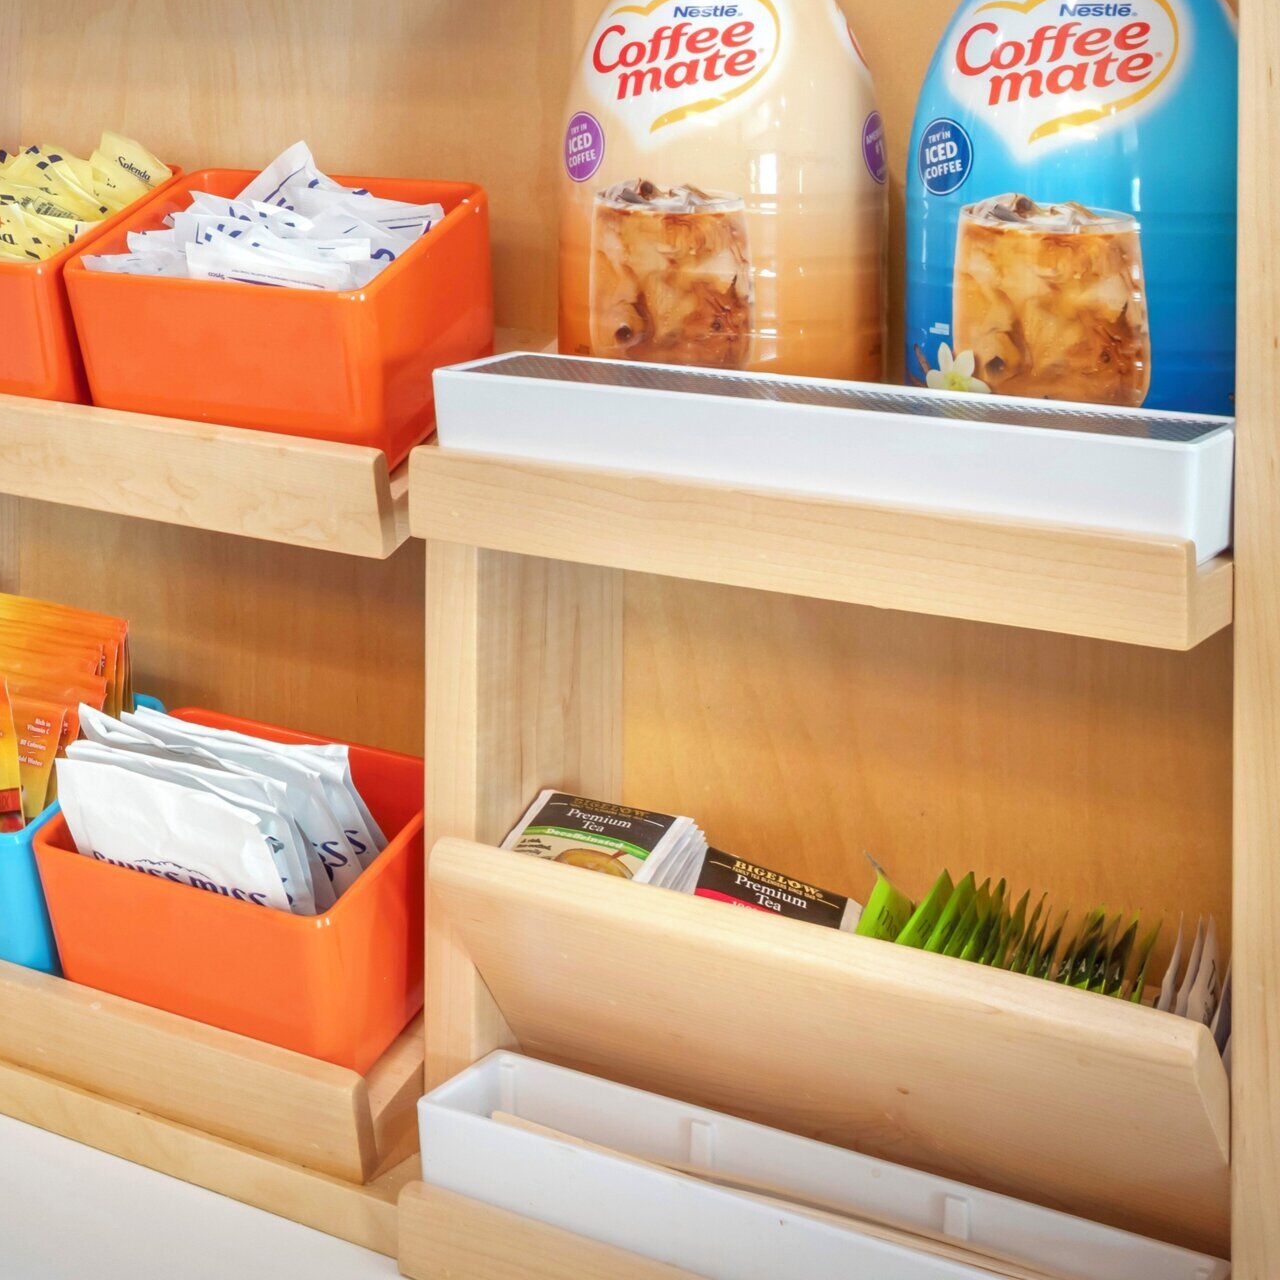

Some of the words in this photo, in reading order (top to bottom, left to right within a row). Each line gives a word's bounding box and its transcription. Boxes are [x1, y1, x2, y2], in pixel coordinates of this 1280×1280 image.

[592, 21, 755, 74] Coffee
[955, 22, 1151, 77] Coffee
[617, 49, 757, 100] mate
[988, 52, 1154, 106] mate
[570, 125, 580, 135] TRY
[580, 123, 587, 132] IN
[927, 134, 941, 144] TRY
[941, 130, 951, 140] IN
[568, 132, 593, 155] ICED
[925, 141, 958, 164] ICED
[115, 155, 152, 182] Splenda
[568, 149, 597, 168] COFFEE
[926, 159, 963, 179] COFFEE
[566, 808, 632, 829] Premium
[582, 820, 605, 833] Tea
[545, 828, 625, 849] Decaffeinated
[734, 874, 808, 909] Premium
[755, 893, 782, 912] Tea
